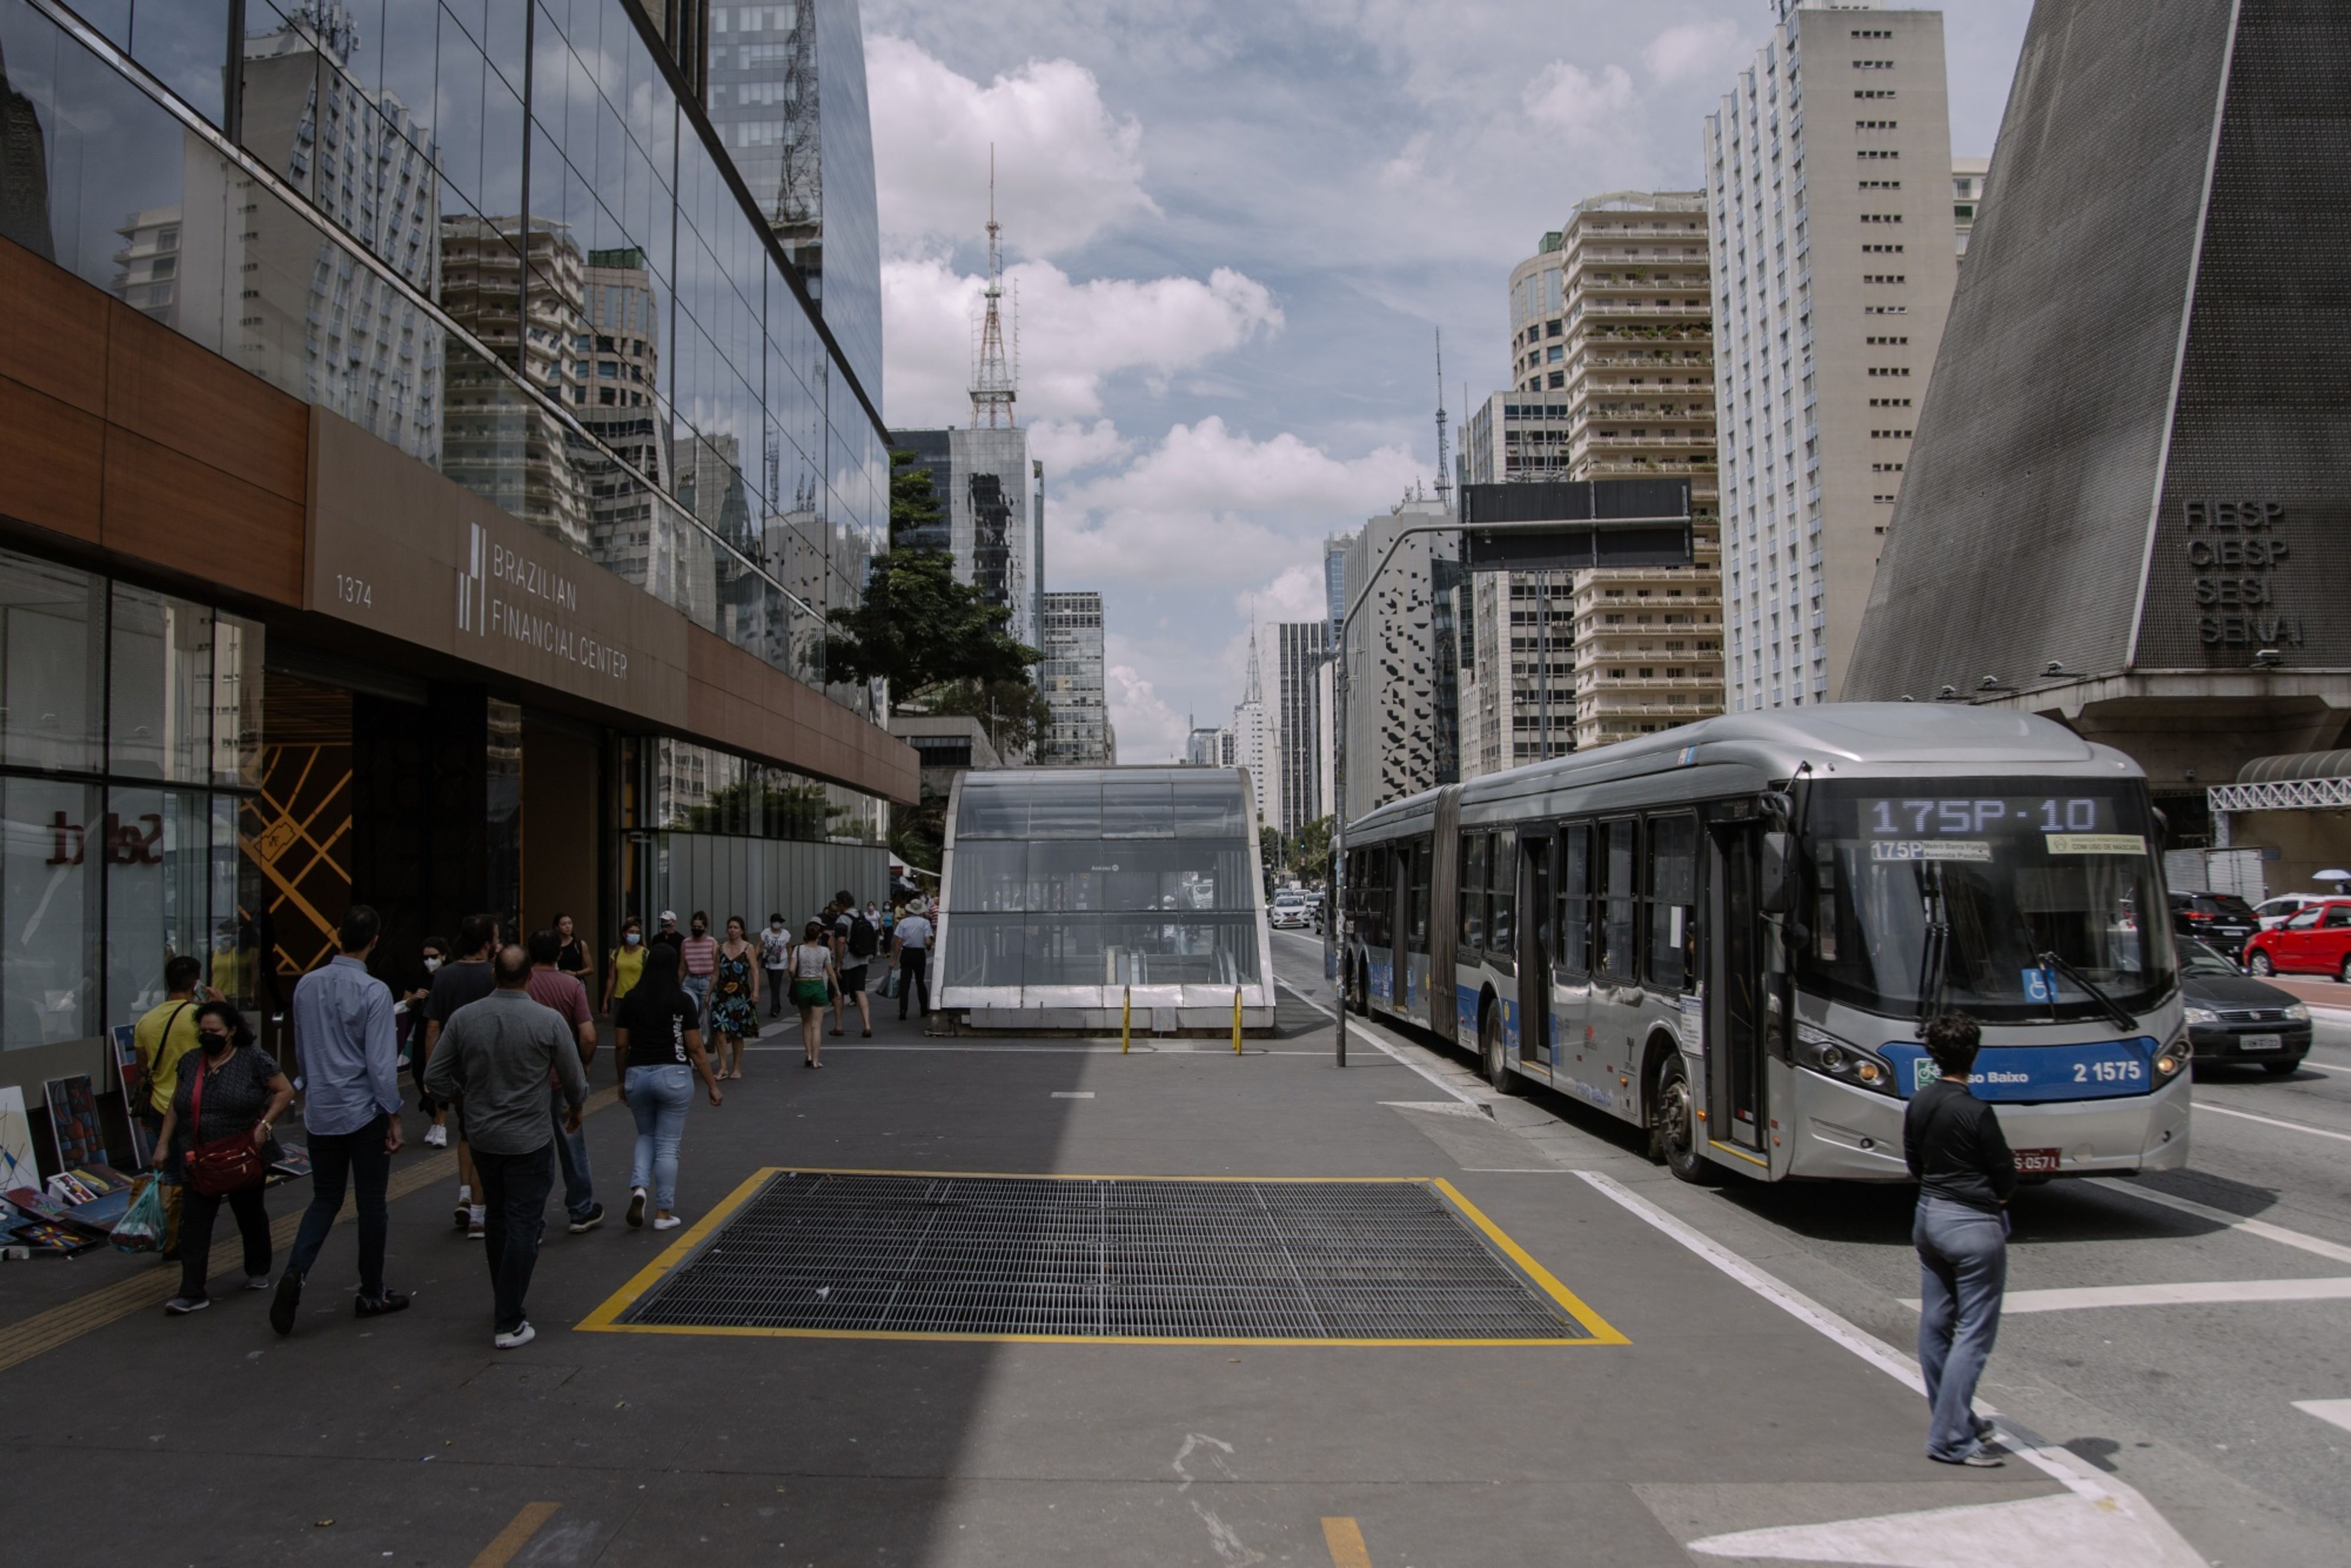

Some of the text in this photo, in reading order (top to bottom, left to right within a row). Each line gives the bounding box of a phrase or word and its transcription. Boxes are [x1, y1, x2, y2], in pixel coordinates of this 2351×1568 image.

[2183, 501, 2285, 527] FIESP
[2188, 537, 2289, 566] CIESP
[337, 573, 372, 609] 1374
[493, 543, 577, 613] BRAZILIAN
[2194, 576, 2272, 604] SESI
[493, 599, 627, 680] FINANCIAL CENTER
[2198, 617, 2303, 643] SENAI
[1872, 842, 1922, 858] 175P
[1967, 1071, 2029, 1084] so Baixo
[2093, 1061, 2141, 1081] 1575
